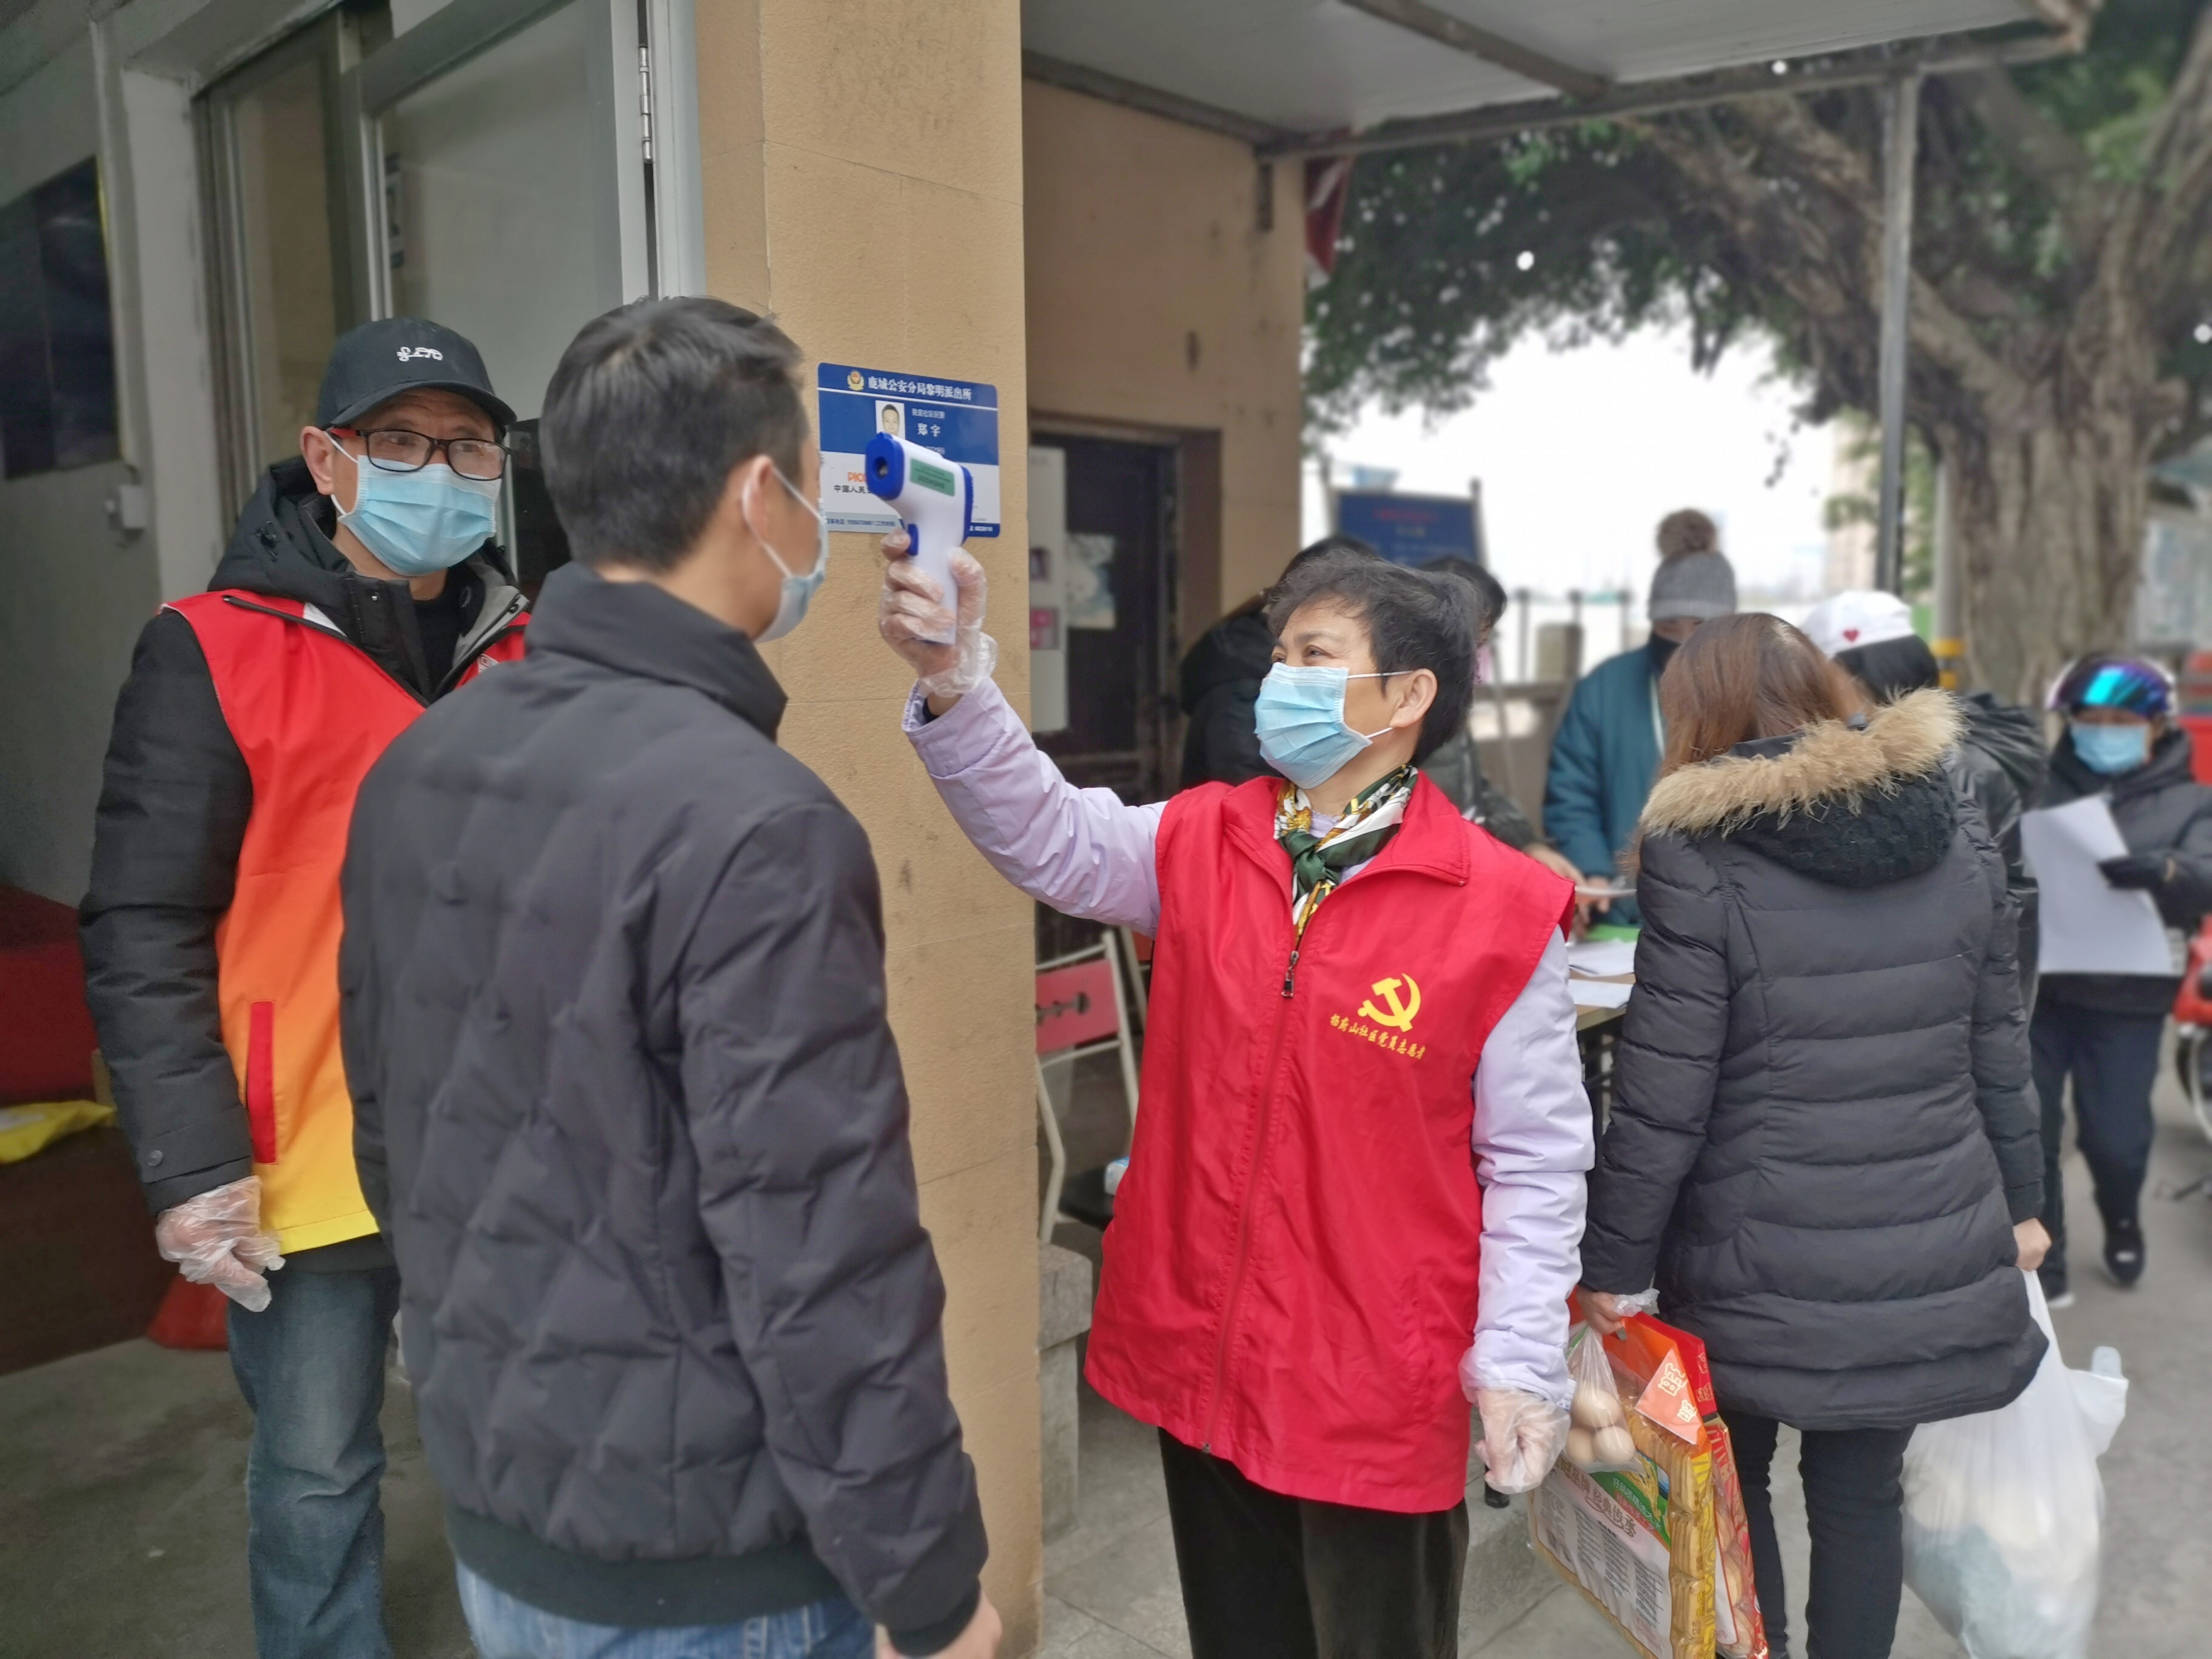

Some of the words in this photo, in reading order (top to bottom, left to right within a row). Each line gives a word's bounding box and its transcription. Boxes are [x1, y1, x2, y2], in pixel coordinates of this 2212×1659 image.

[868, 376, 971, 400] 鹿城公安分局黎明派出所
[847, 472, 865, 483] PIC
[833, 484, 871, 494] 中国人民
